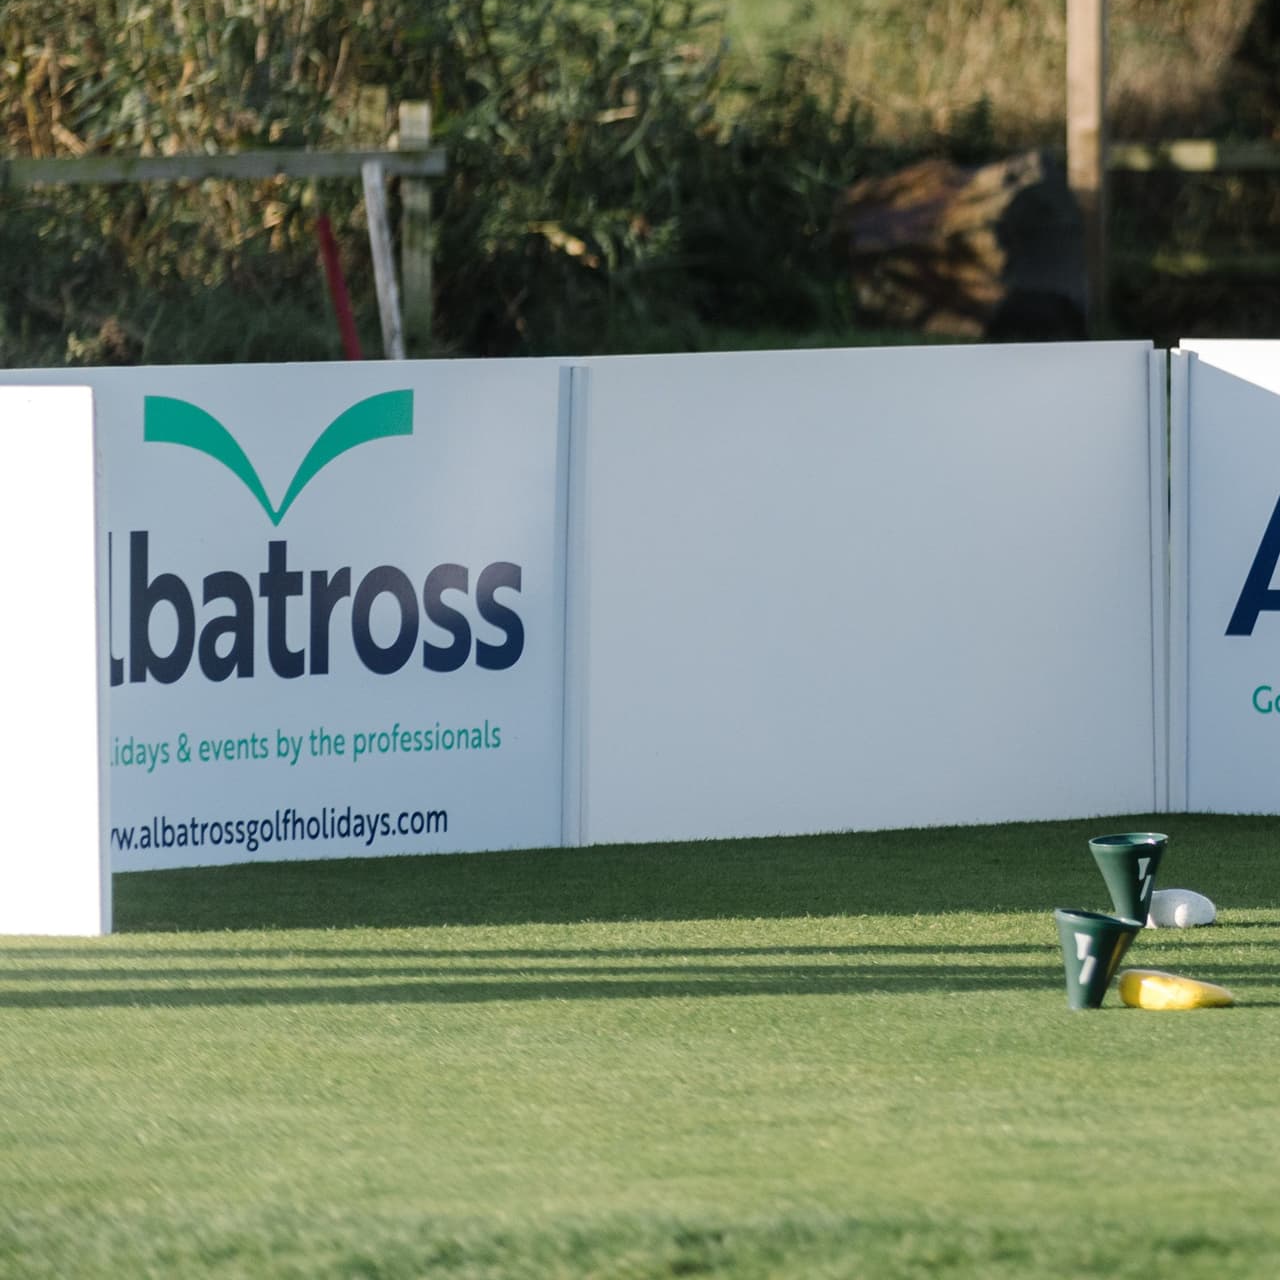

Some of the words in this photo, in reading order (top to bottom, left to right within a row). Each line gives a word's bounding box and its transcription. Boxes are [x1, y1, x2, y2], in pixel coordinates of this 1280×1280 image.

[108, 530, 525, 687] batross
[110, 736, 170, 773] idays
[176, 733, 191, 762] &
[199, 732, 269, 762] events
[277, 729, 303, 766] by
[309, 727, 345, 757] the
[353, 720, 502, 762] professionals
[111, 807, 448, 852] w.albatrossgolfholidays.com
